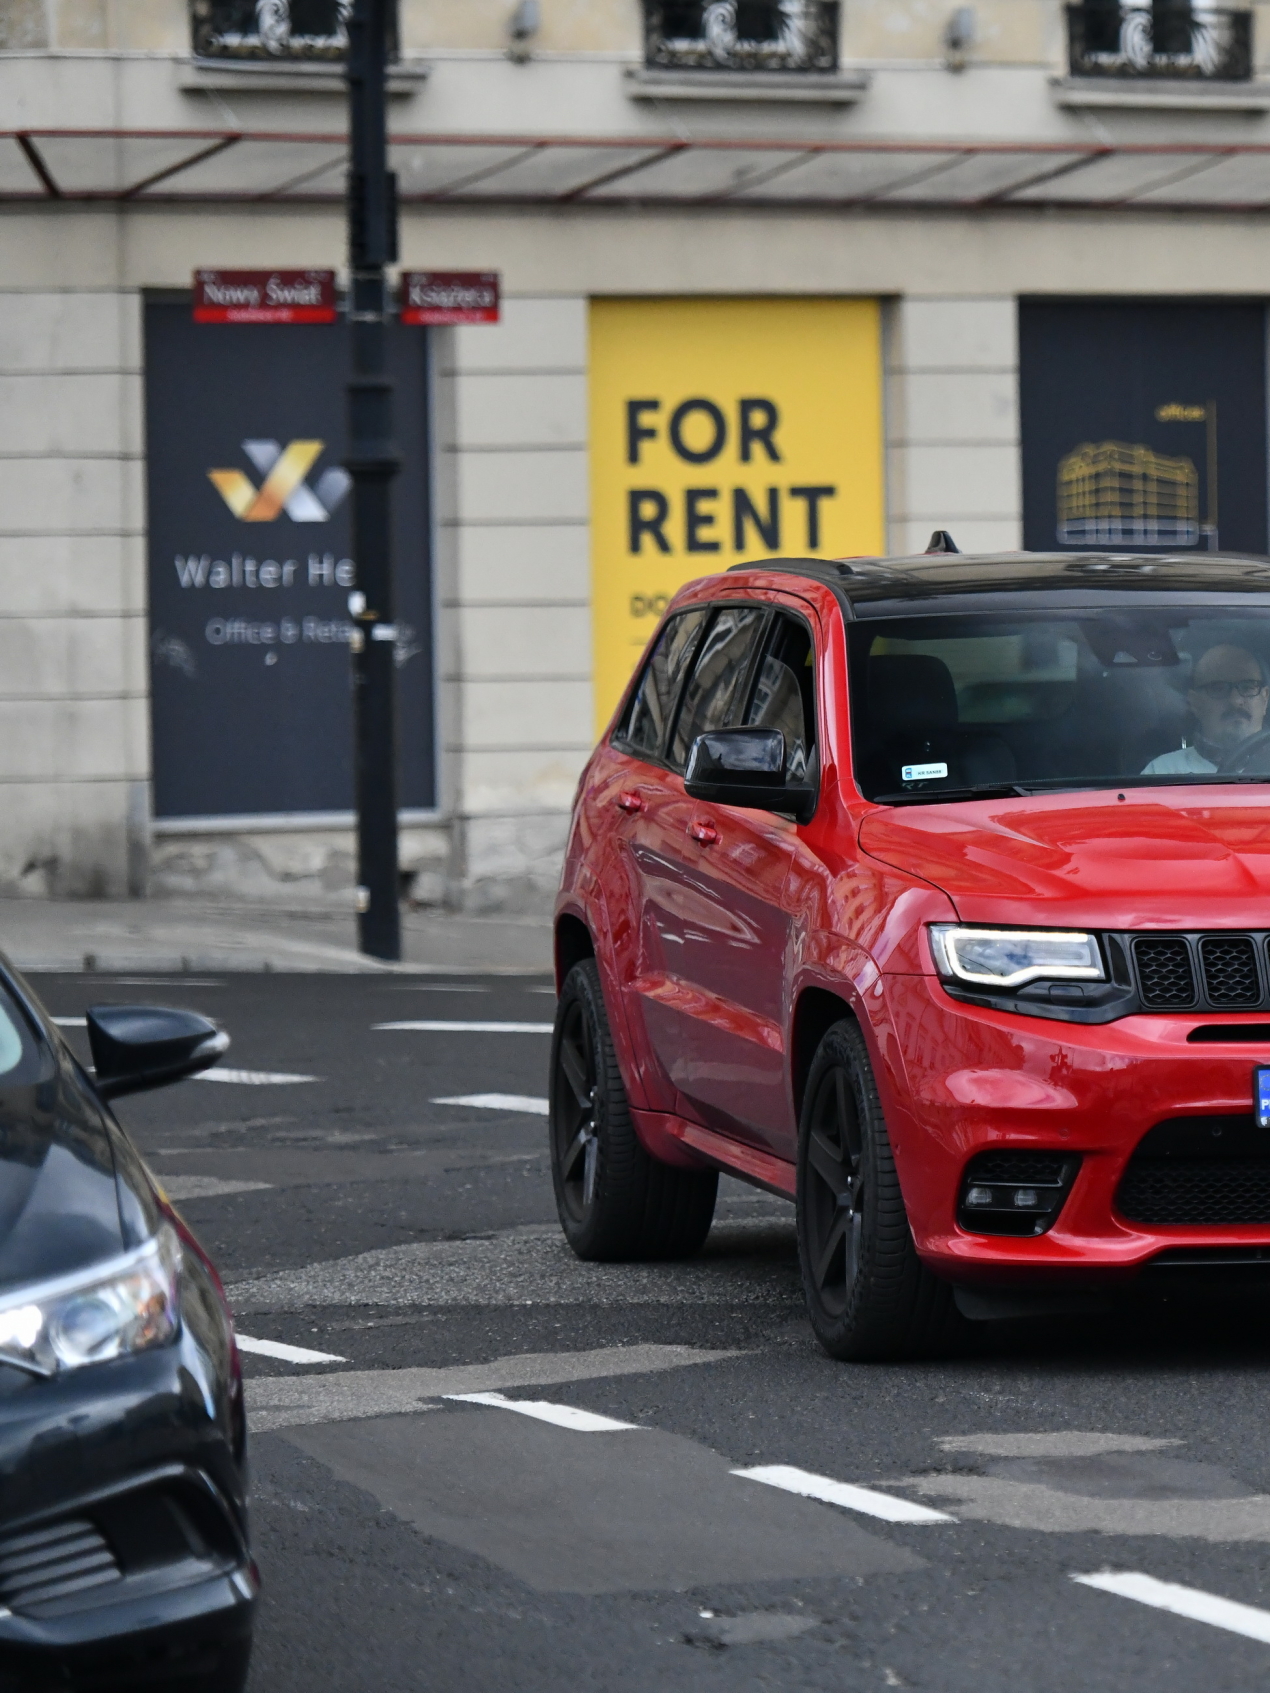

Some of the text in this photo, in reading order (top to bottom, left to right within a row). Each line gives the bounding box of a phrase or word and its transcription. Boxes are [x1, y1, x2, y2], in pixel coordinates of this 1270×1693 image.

[203, 272, 322, 308] Nowy Świat
[625, 396, 782, 465] FOR
[627, 486, 836, 555] RENT
[174, 552, 298, 588] Walter
[205, 617, 278, 645] Office
